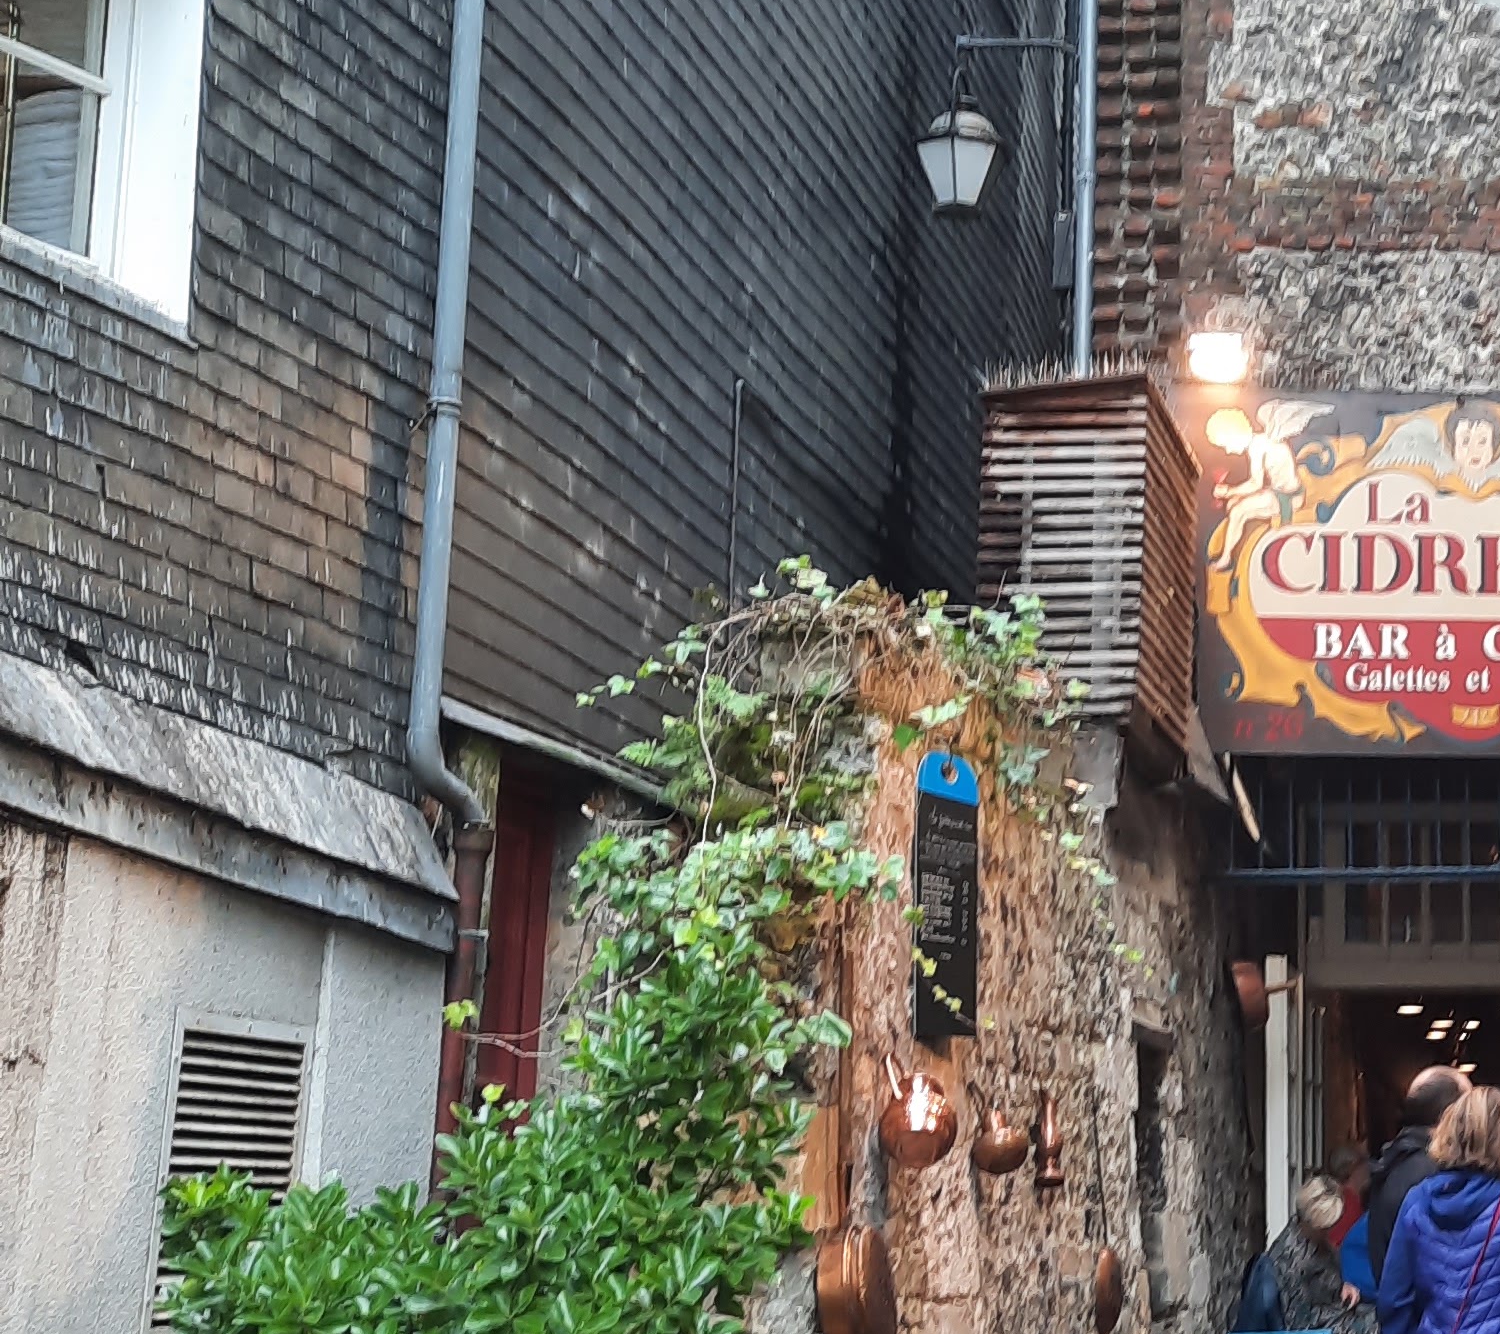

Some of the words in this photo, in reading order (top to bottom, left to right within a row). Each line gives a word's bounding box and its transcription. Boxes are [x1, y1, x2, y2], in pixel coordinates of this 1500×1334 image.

[1365, 480, 1432, 525] La
[1313, 623, 1411, 662] BAR
[1436, 623, 1457, 661] à
[1345, 664, 1451, 694] Galettes
[1465, 666, 1491, 694] et
